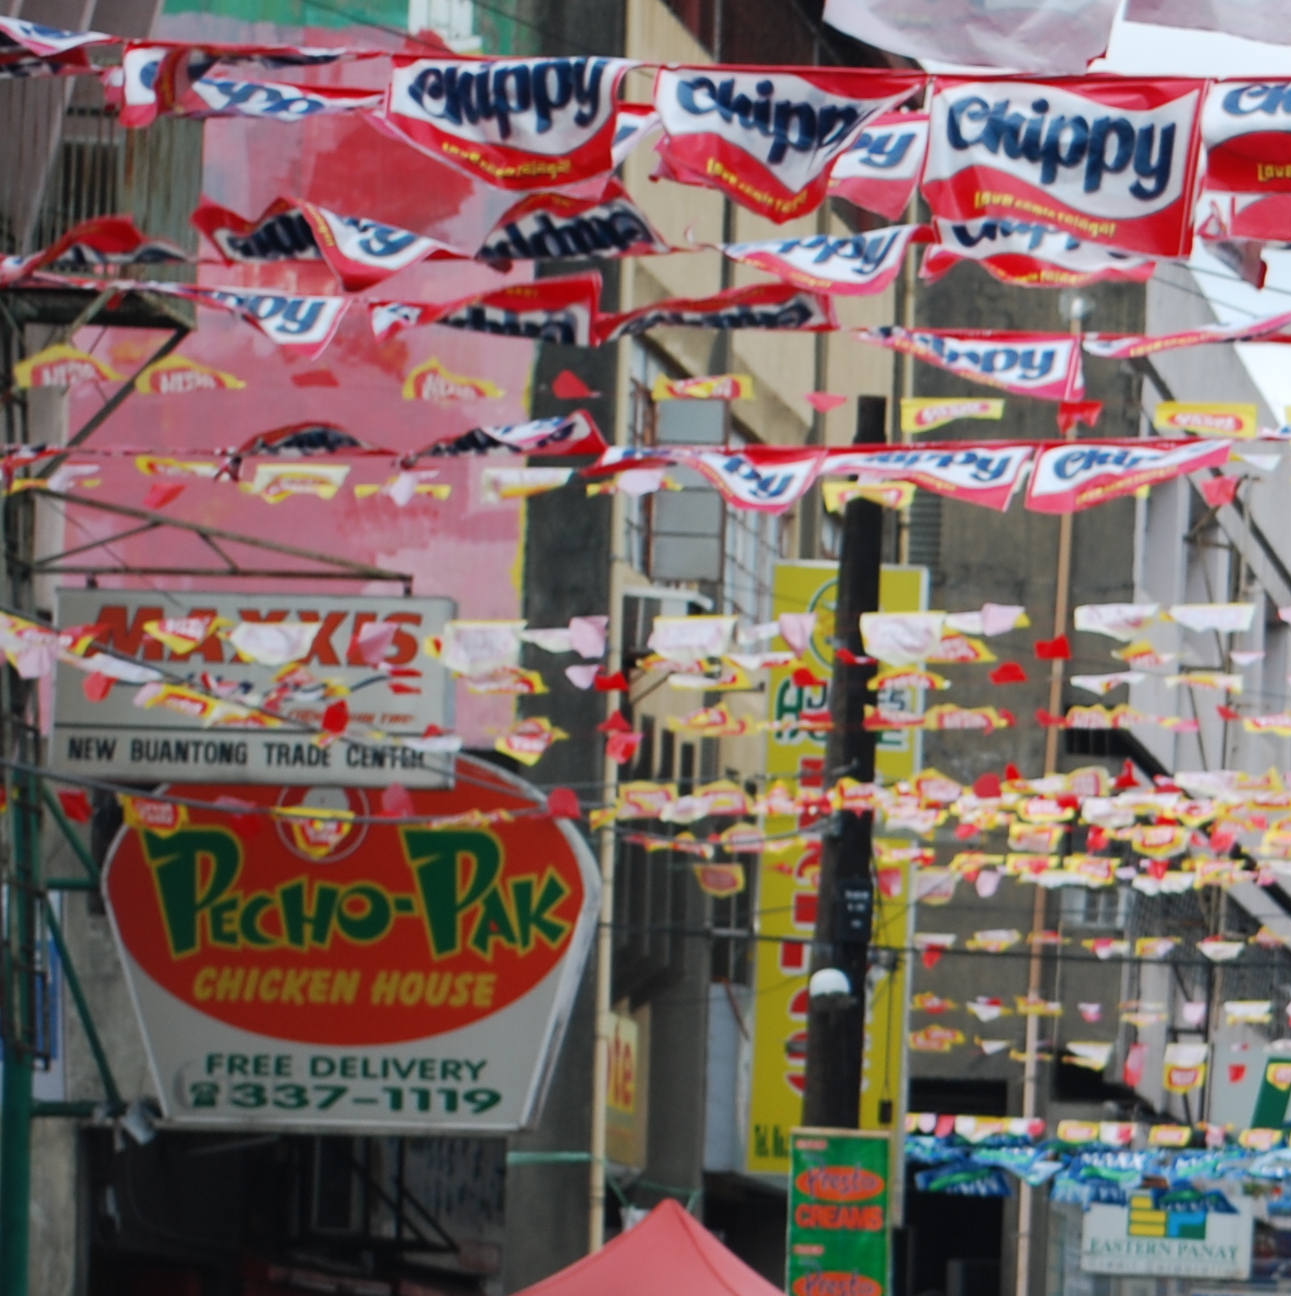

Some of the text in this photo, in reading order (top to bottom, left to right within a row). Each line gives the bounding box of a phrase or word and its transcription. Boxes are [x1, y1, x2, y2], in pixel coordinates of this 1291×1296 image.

[947, 97, 1177, 201] Chippy
[68, 736, 117, 763] NEW
[129, 738, 248, 766] BUANTONG
[263, 740, 331, 768] TRADE
[193, 966, 498, 1009] CHICKEN HOUSE
[204, 1052, 489, 1082] FREE DELIVERY
[229, 1082, 504, 1115] 337-1119
[795, 1203, 884, 1231] CREAMS
[1089, 1238, 1240, 1261] EASTERN PANAY
